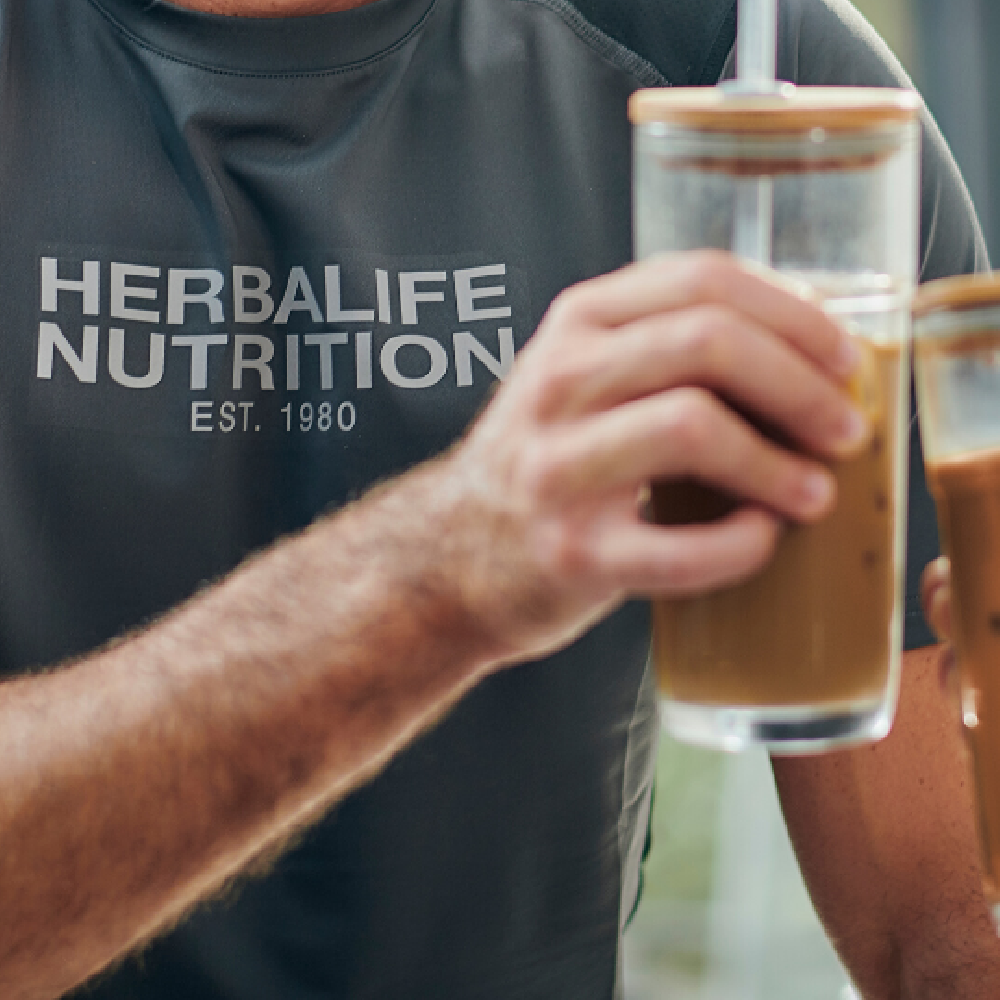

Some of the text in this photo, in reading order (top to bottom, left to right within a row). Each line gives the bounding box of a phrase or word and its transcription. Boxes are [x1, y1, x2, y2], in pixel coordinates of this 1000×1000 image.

[41, 257, 511, 324] HERBALIFE
[36, 322, 514, 389] NUTRITION
[190, 401, 357, 432] EST. 1980
